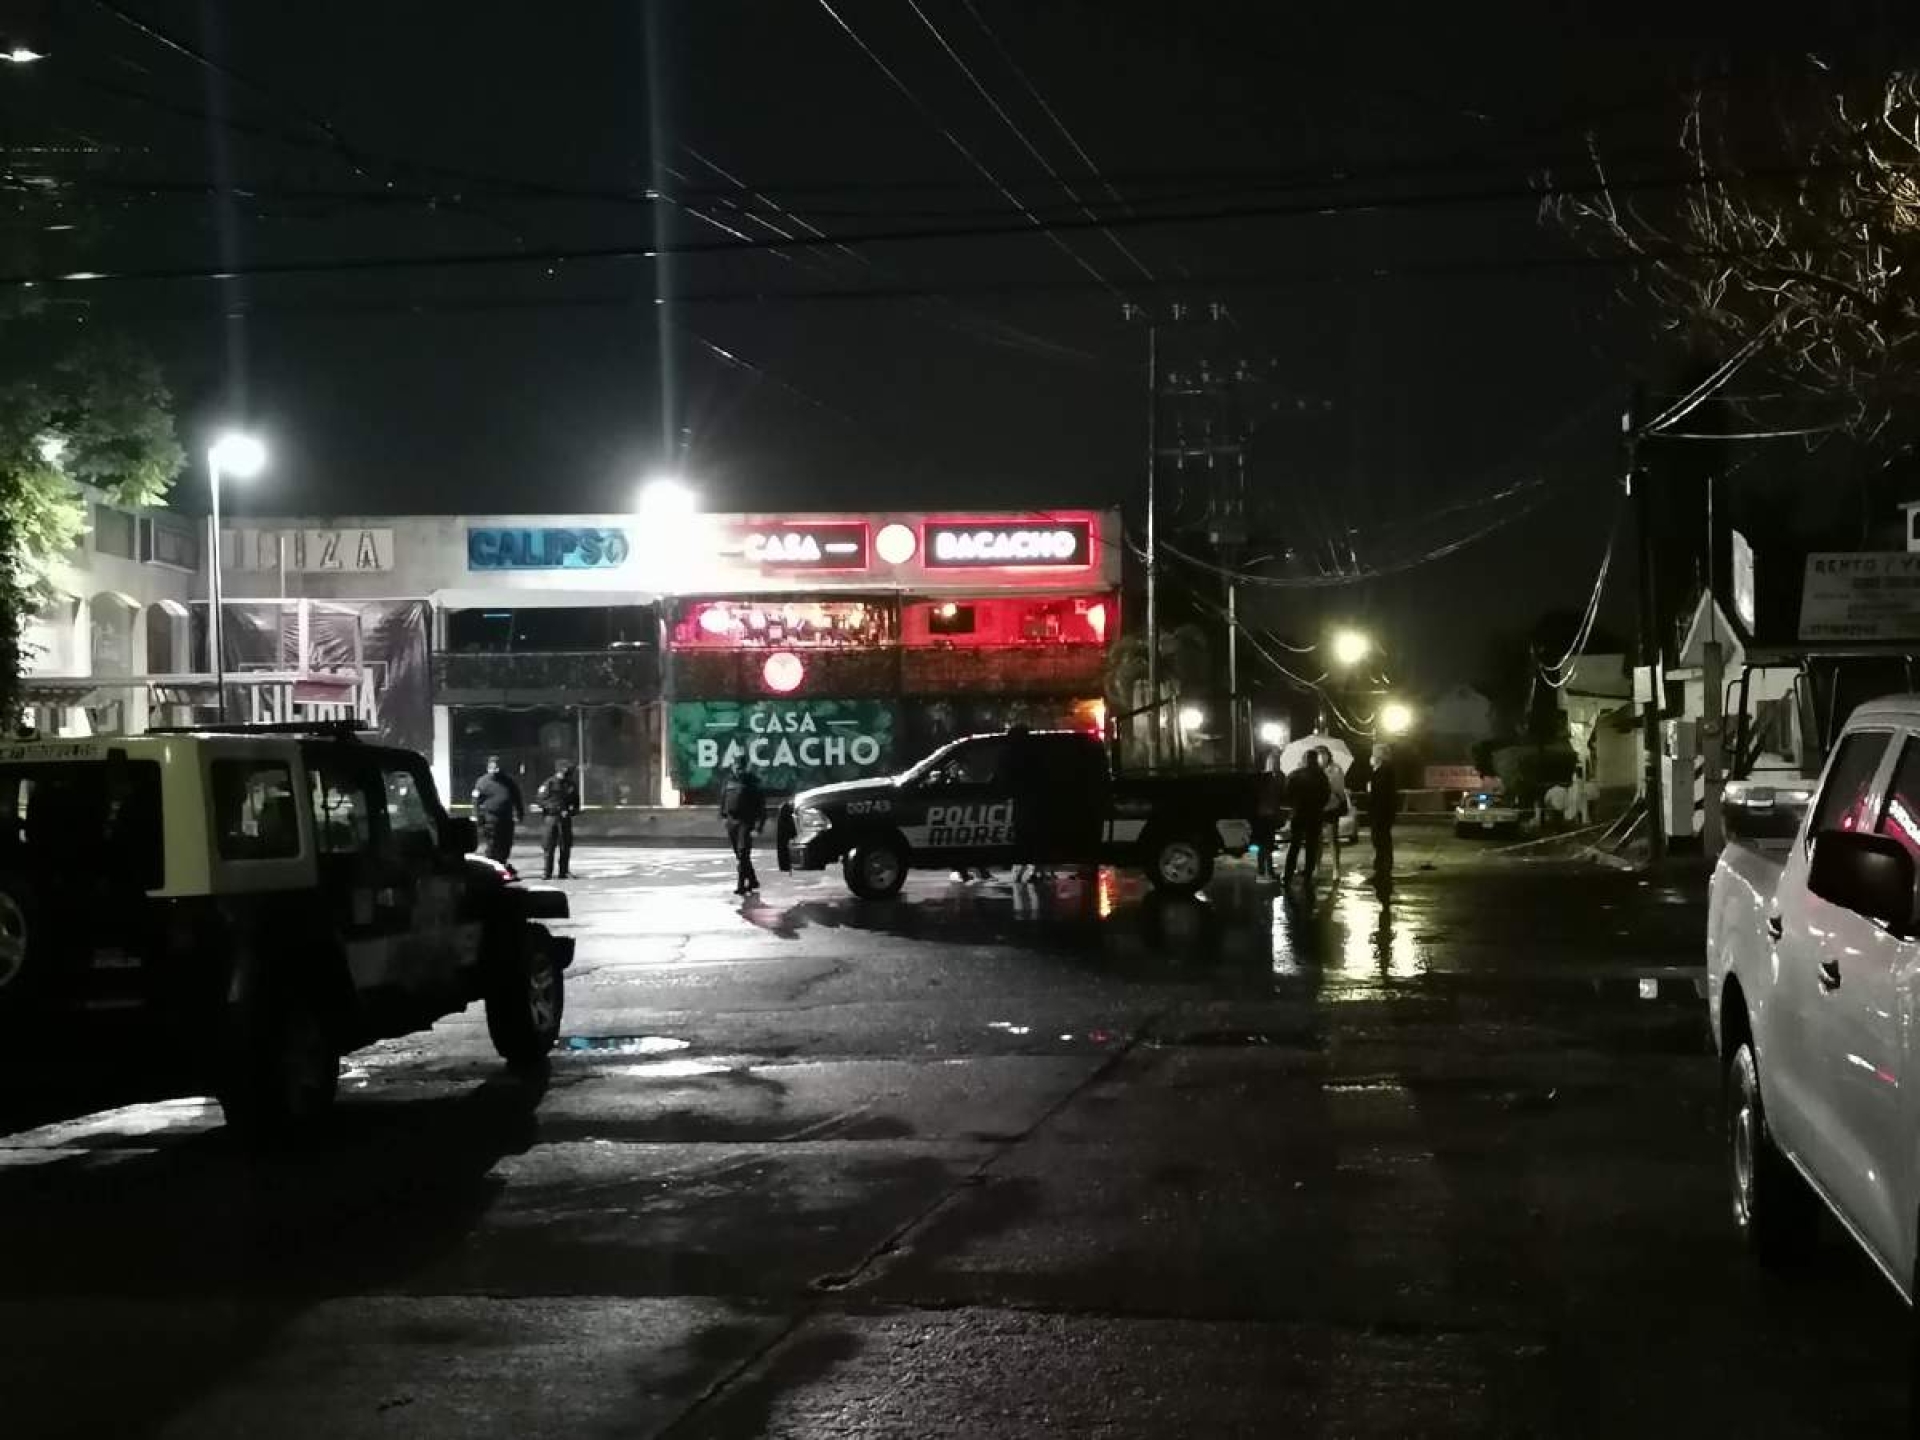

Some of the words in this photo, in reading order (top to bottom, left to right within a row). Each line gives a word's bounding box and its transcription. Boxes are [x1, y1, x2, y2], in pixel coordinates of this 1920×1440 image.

[471, 528, 629, 567] CALIPSO
[743, 533, 820, 561] CASA
[934, 530, 1076, 560] BACACHO
[749, 711, 817, 734] CASA
[696, 735, 881, 769] BACACHO
